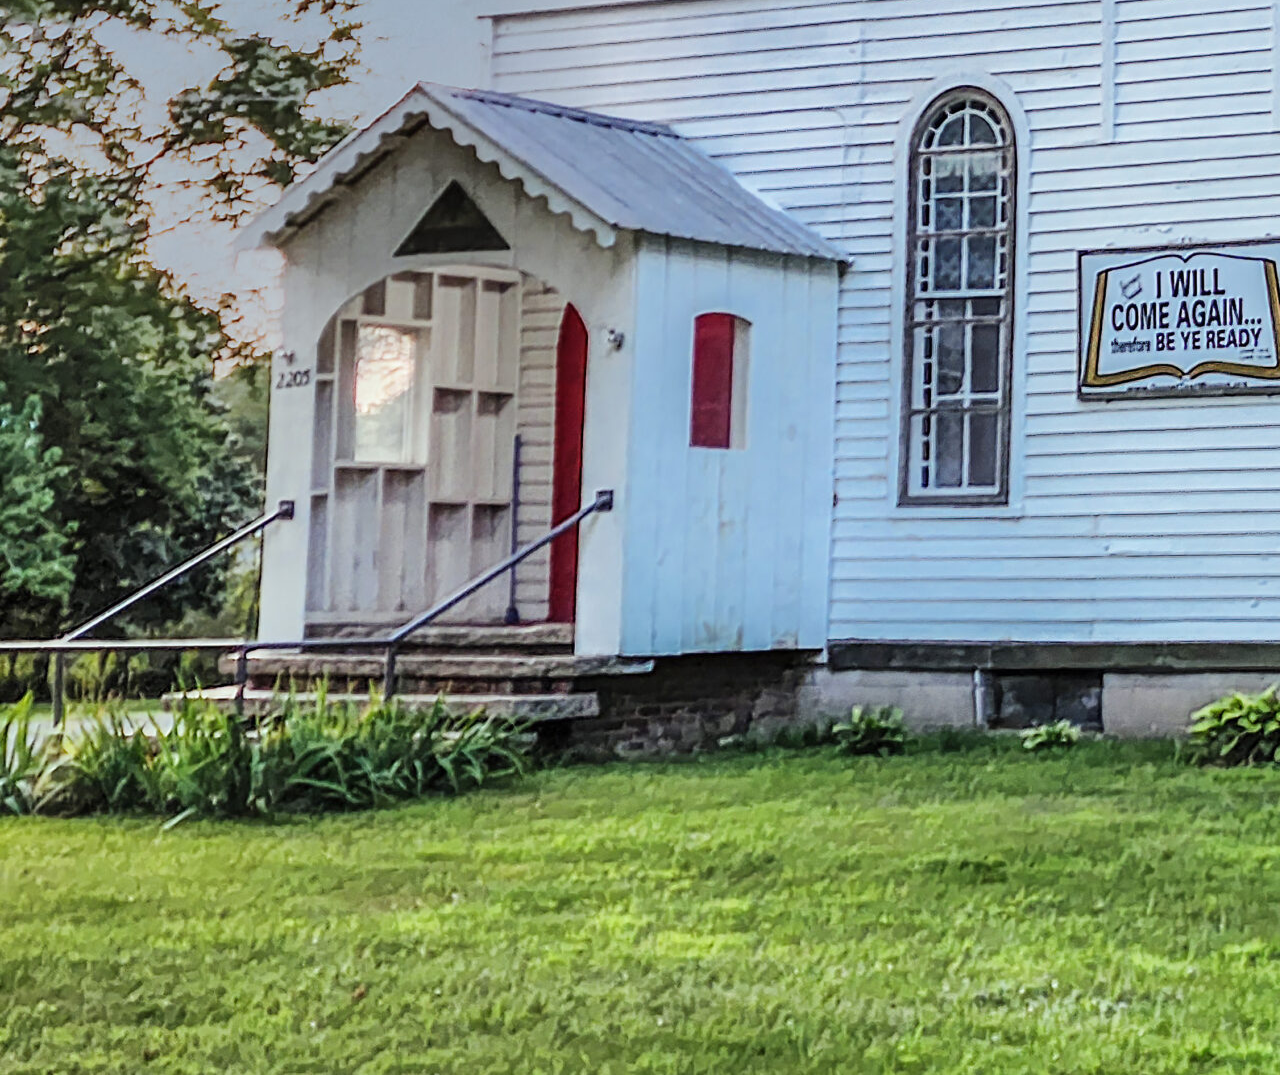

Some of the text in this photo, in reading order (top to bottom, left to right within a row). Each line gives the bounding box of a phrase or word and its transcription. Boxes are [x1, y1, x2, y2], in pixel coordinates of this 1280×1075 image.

[1156, 268, 1226, 298] I WILL
[1111, 297, 1262, 331] COME AGAIN...
[1155, 332, 1176, 351] BE
[1181, 330, 1201, 350] YE
[1206, 327, 1262, 348] READY
